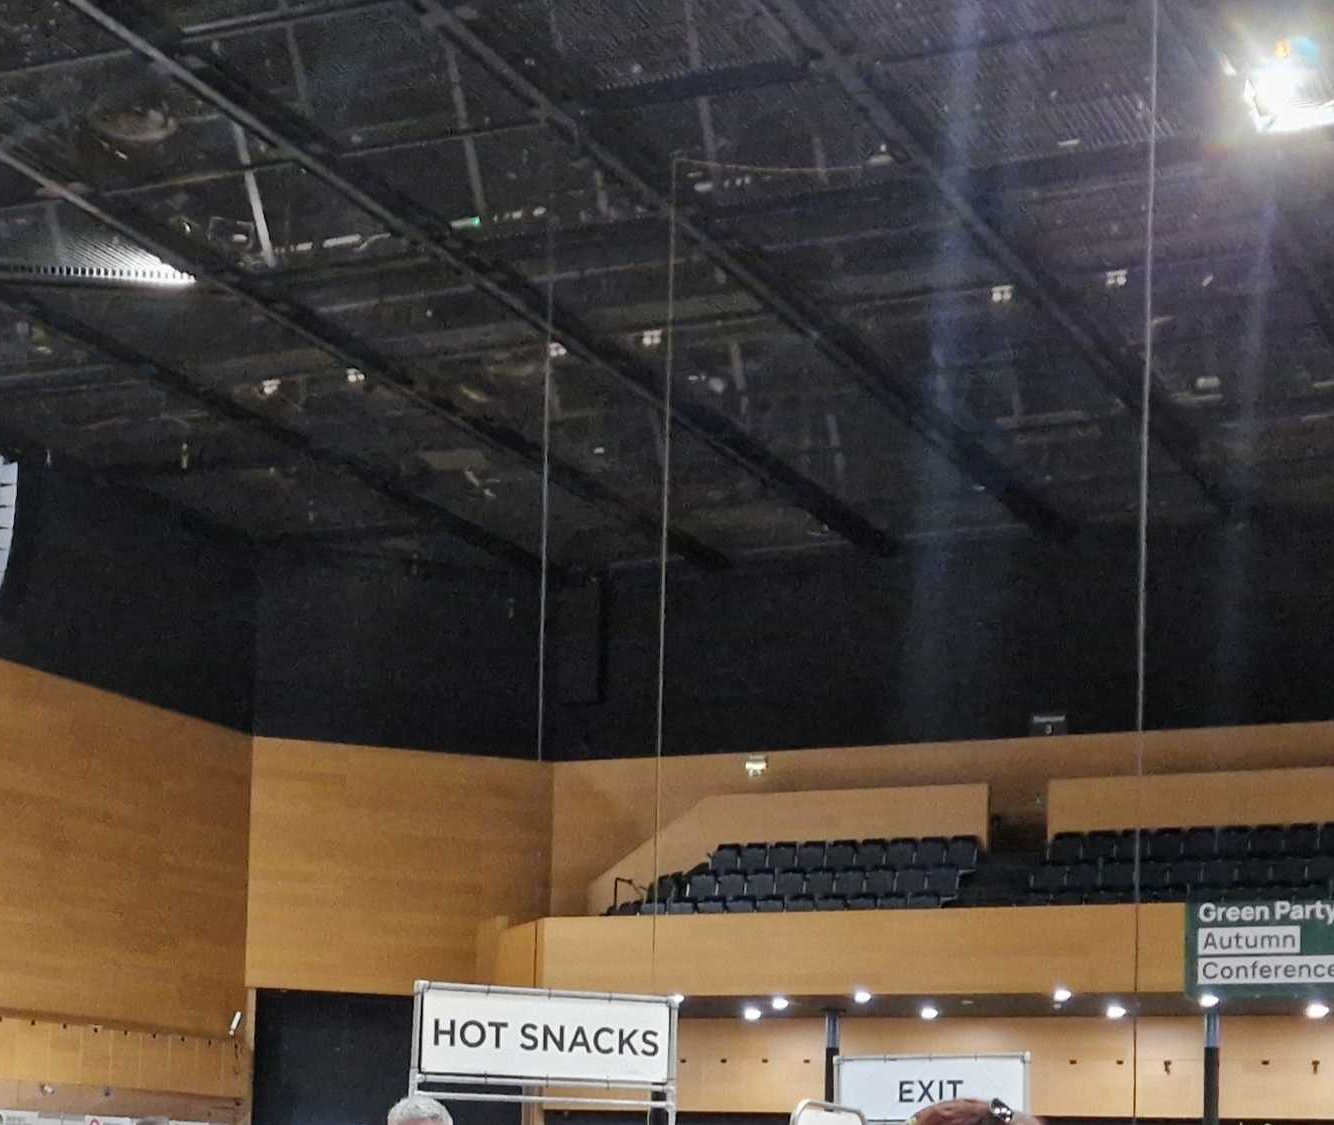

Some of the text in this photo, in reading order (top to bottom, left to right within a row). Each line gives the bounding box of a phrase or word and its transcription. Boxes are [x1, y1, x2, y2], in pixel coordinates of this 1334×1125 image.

[1199, 902, 1270, 922] Green
[1203, 931, 1296, 950] Autumn
[433, 1018, 659, 1057] HOT SNACKS
[899, 1080, 964, 1102] EXIT
